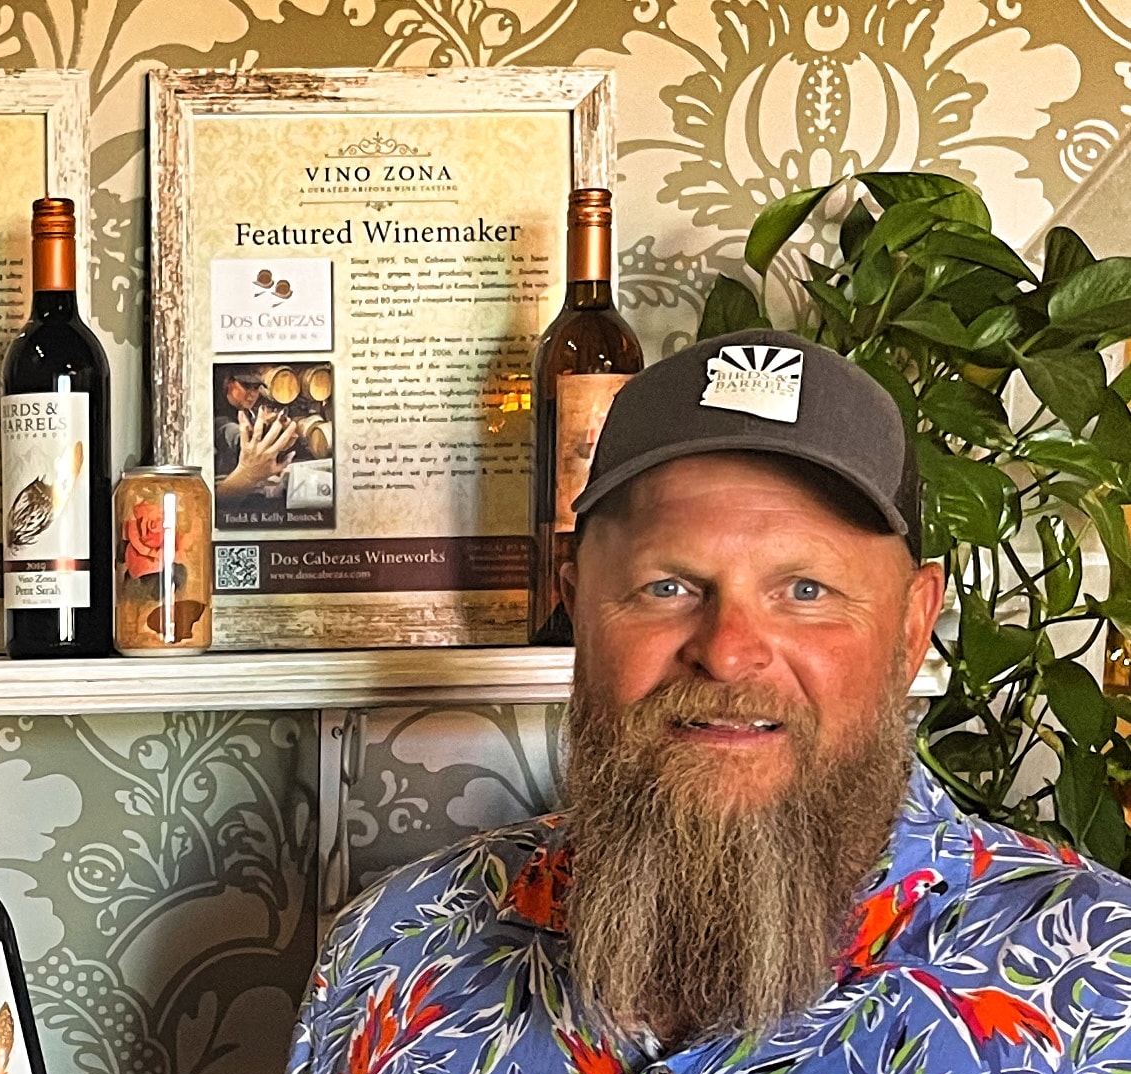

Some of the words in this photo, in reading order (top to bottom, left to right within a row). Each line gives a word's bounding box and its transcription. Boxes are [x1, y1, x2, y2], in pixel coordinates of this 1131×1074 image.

[306, 167, 370, 182] VINO
[384, 166, 451, 181] ZONA
[235, 220, 352, 246] Featured
[363, 218, 521, 244] Winemaker
[221, 314, 252, 328] DOS
[258, 313, 325, 327] CABEZAS
[717, 371, 770, 381] BIRDS
[776, 374, 788, 382] &
[716, 380, 795, 392] BARRELS
[46, 402, 58, 415] &
[224, 513, 248, 524] Todd
[251, 514, 259, 523] &
[261, 512, 285, 525] Kelly
[287, 512, 324, 523] Bostock
[270, 551, 299, 567] Dos
[302, 551, 361, 566] Cabezas
[365, 549, 445, 565] Wineworks
